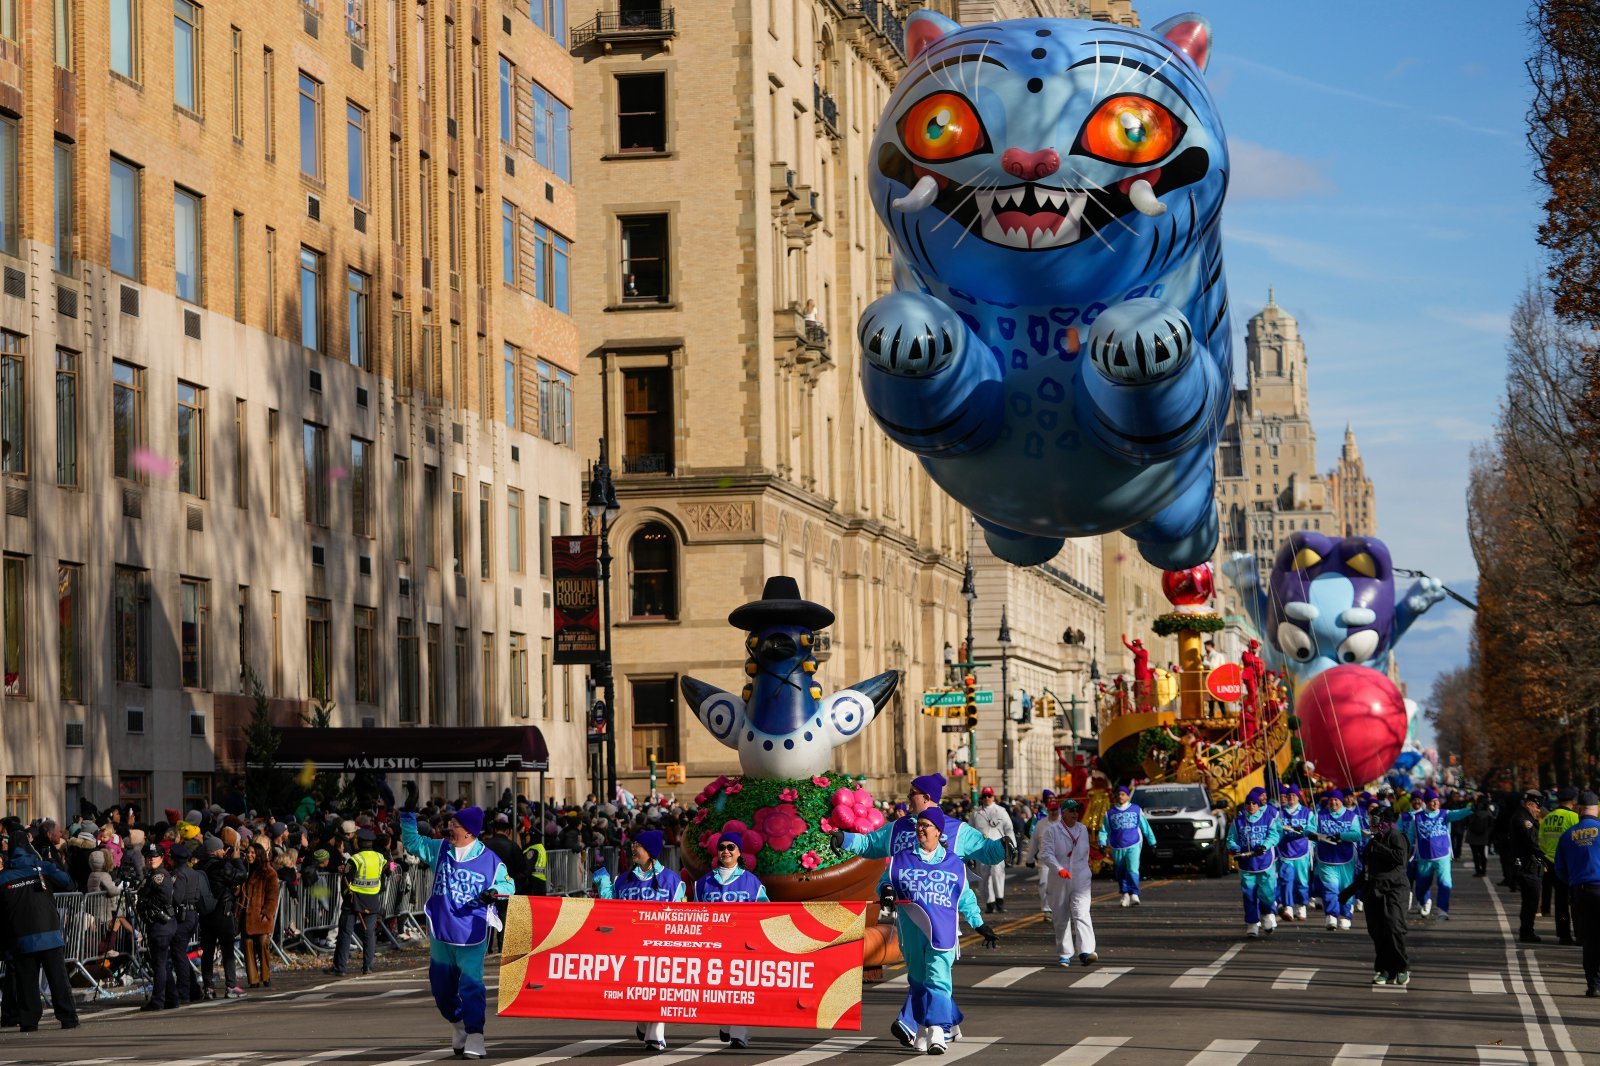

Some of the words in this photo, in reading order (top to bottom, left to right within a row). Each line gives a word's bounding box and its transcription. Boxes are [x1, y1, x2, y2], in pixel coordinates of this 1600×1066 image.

[556, 579, 591, 594] MOULIN
[346, 757, 421, 769] MAJESTIC
[477, 758, 494, 768] 115
[900, 880, 956, 898] DEMON
[638, 911, 710, 923] THANKSGIVING
[712, 912, 732, 923] DAY
[664, 923, 703, 936] PARADE
[642, 939, 723, 949] PRESENTS
[548, 953, 627, 982] DERPY
[633, 955, 702, 985] TIGER
[707, 958, 723, 985] &
[729, 958, 815, 989] SUSSIE
[603, 990, 624, 1000] FROM
[626, 986, 657, 1001] KPOP
[659, 987, 700, 1003] DEMON
[702, 989, 755, 1005] HUNTERS
[660, 1006, 697, 1018] NETFLIX
